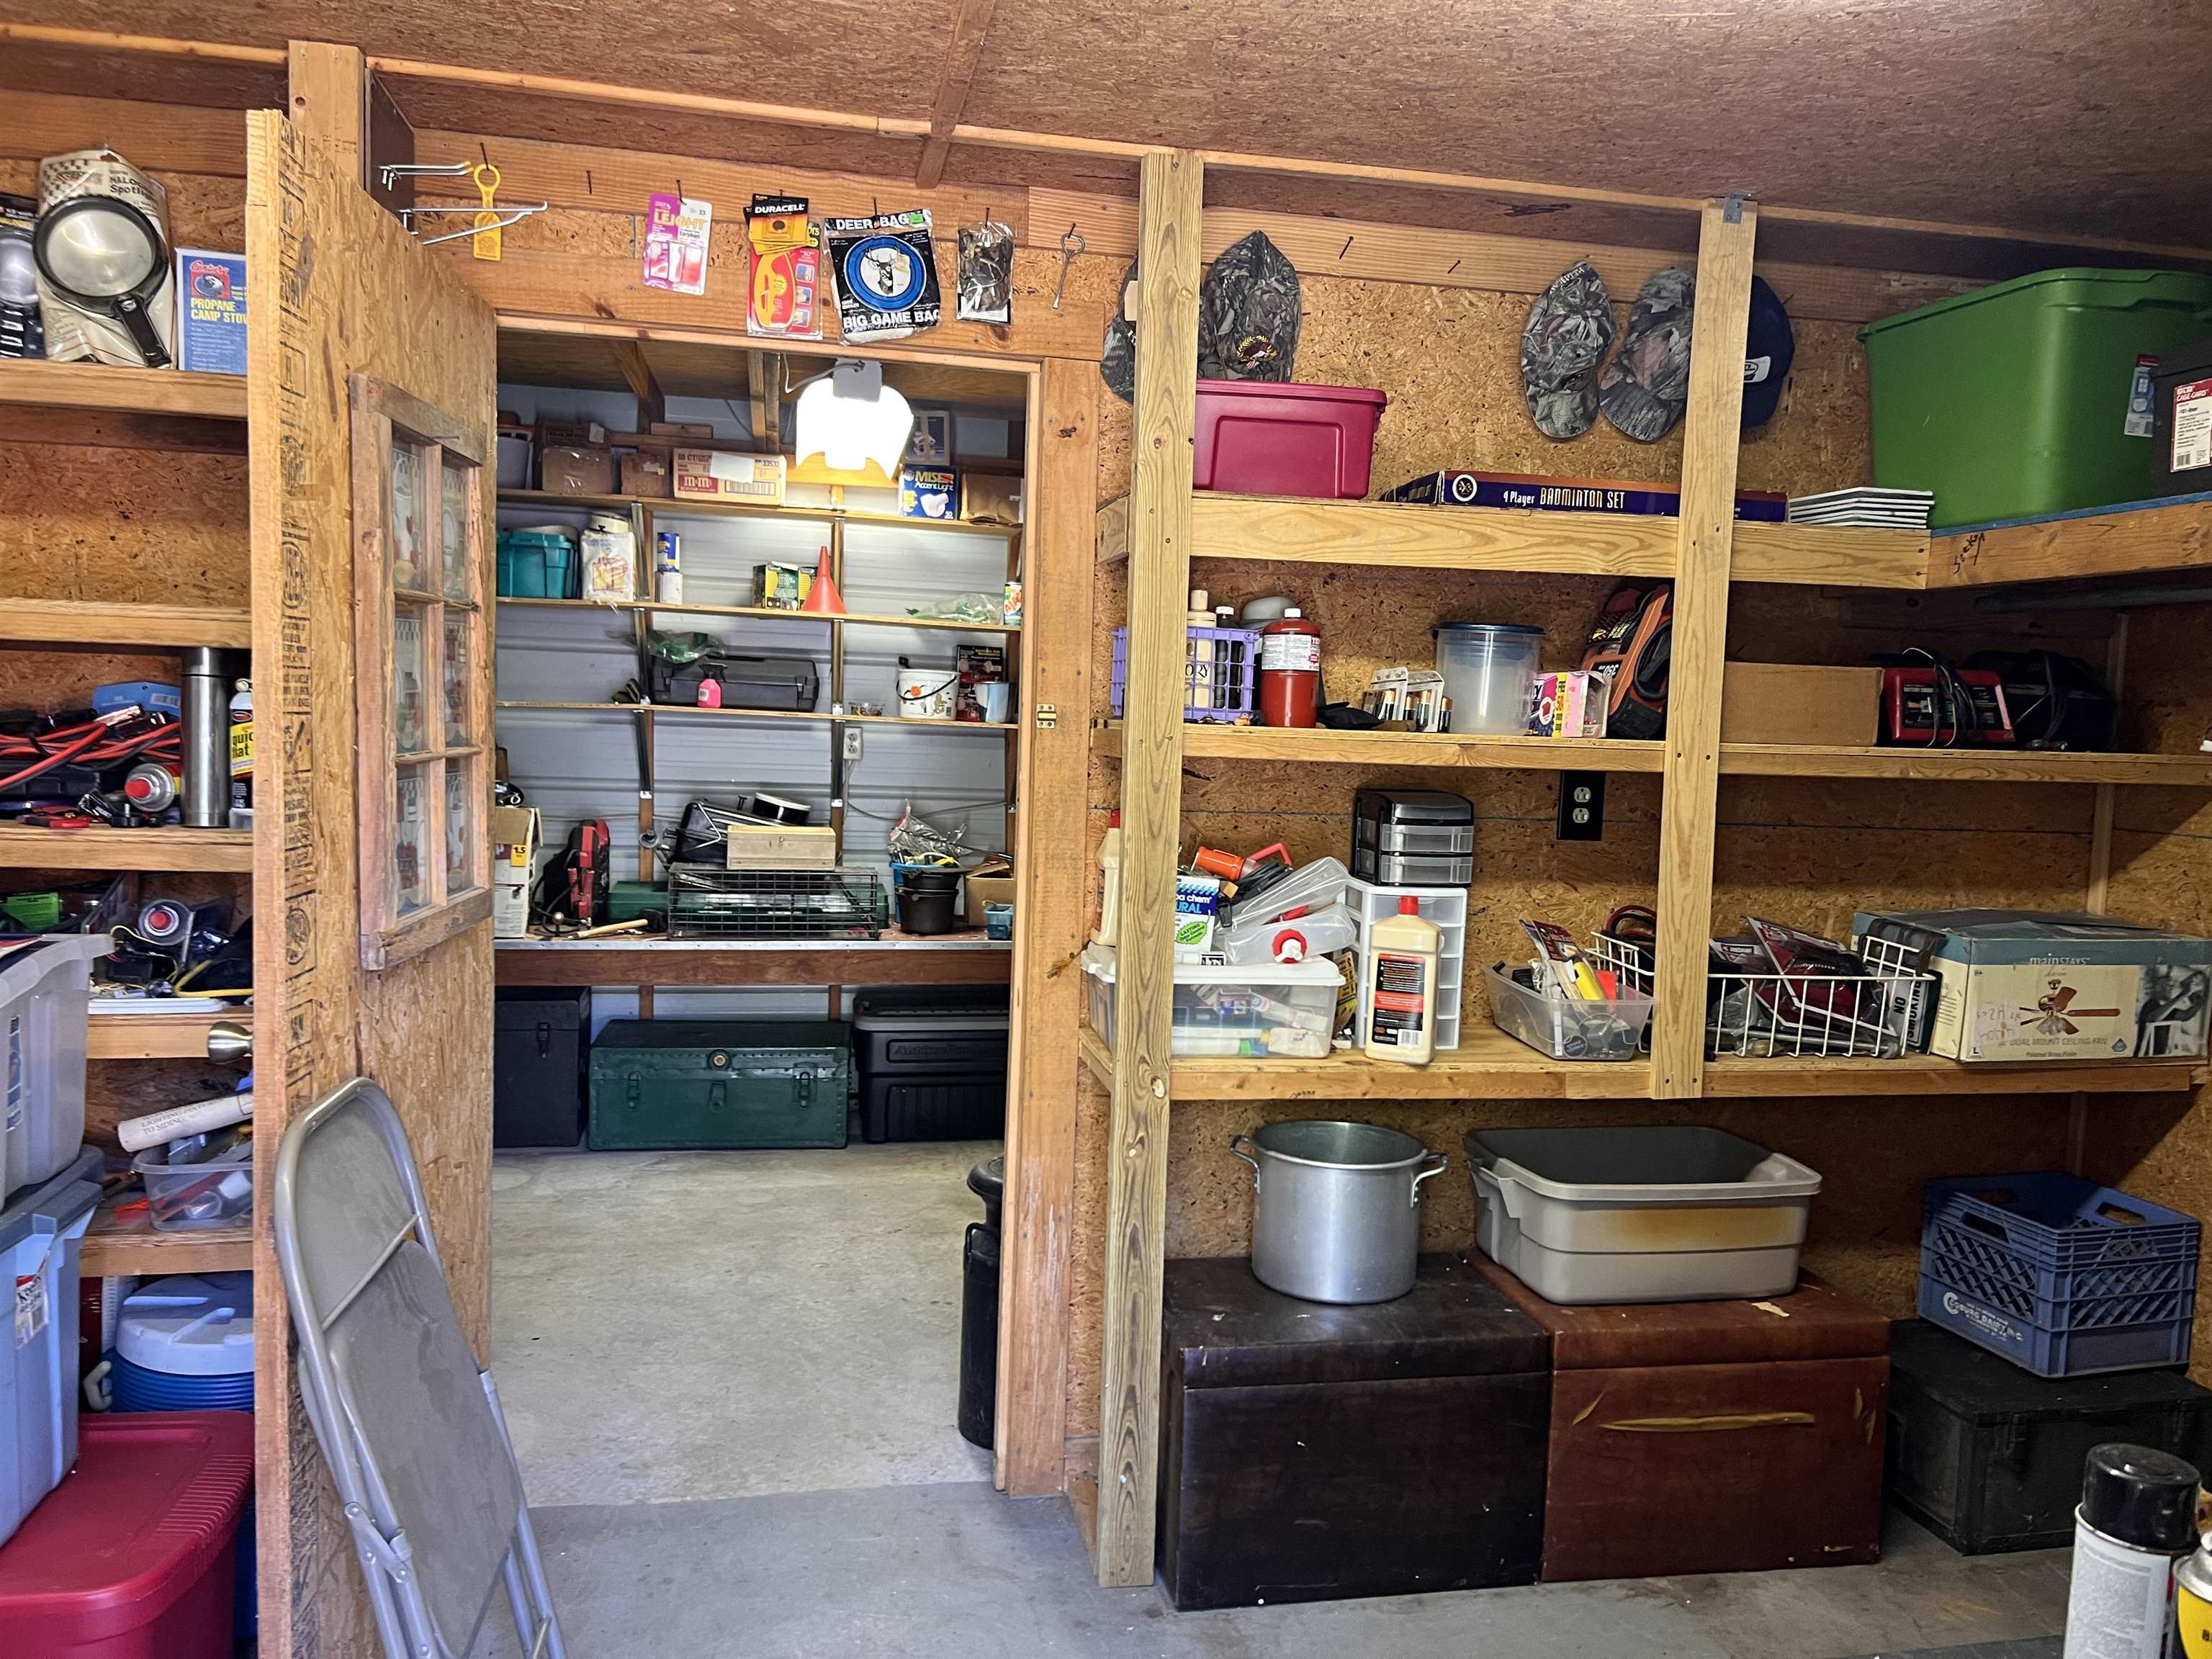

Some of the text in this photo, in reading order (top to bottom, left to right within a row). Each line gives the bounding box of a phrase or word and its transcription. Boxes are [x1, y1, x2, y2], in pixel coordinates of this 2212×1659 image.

[755, 204, 805, 214] DURACELL
[836, 218, 873, 230] DEER
[191, 297, 236, 312] PROPANE
[191, 309, 221, 323] CAMP
[843, 315, 868, 329] BIG
[871, 311, 912, 325] GAME
[915, 471, 955, 484] MISER
[1503, 487, 1625, 509] 4 Player BADMINTON SET
[1187, 894, 1210, 904] chem
[1893, 996, 1906, 1015] NO
[1907, 981, 1922, 1038] SMOKING
